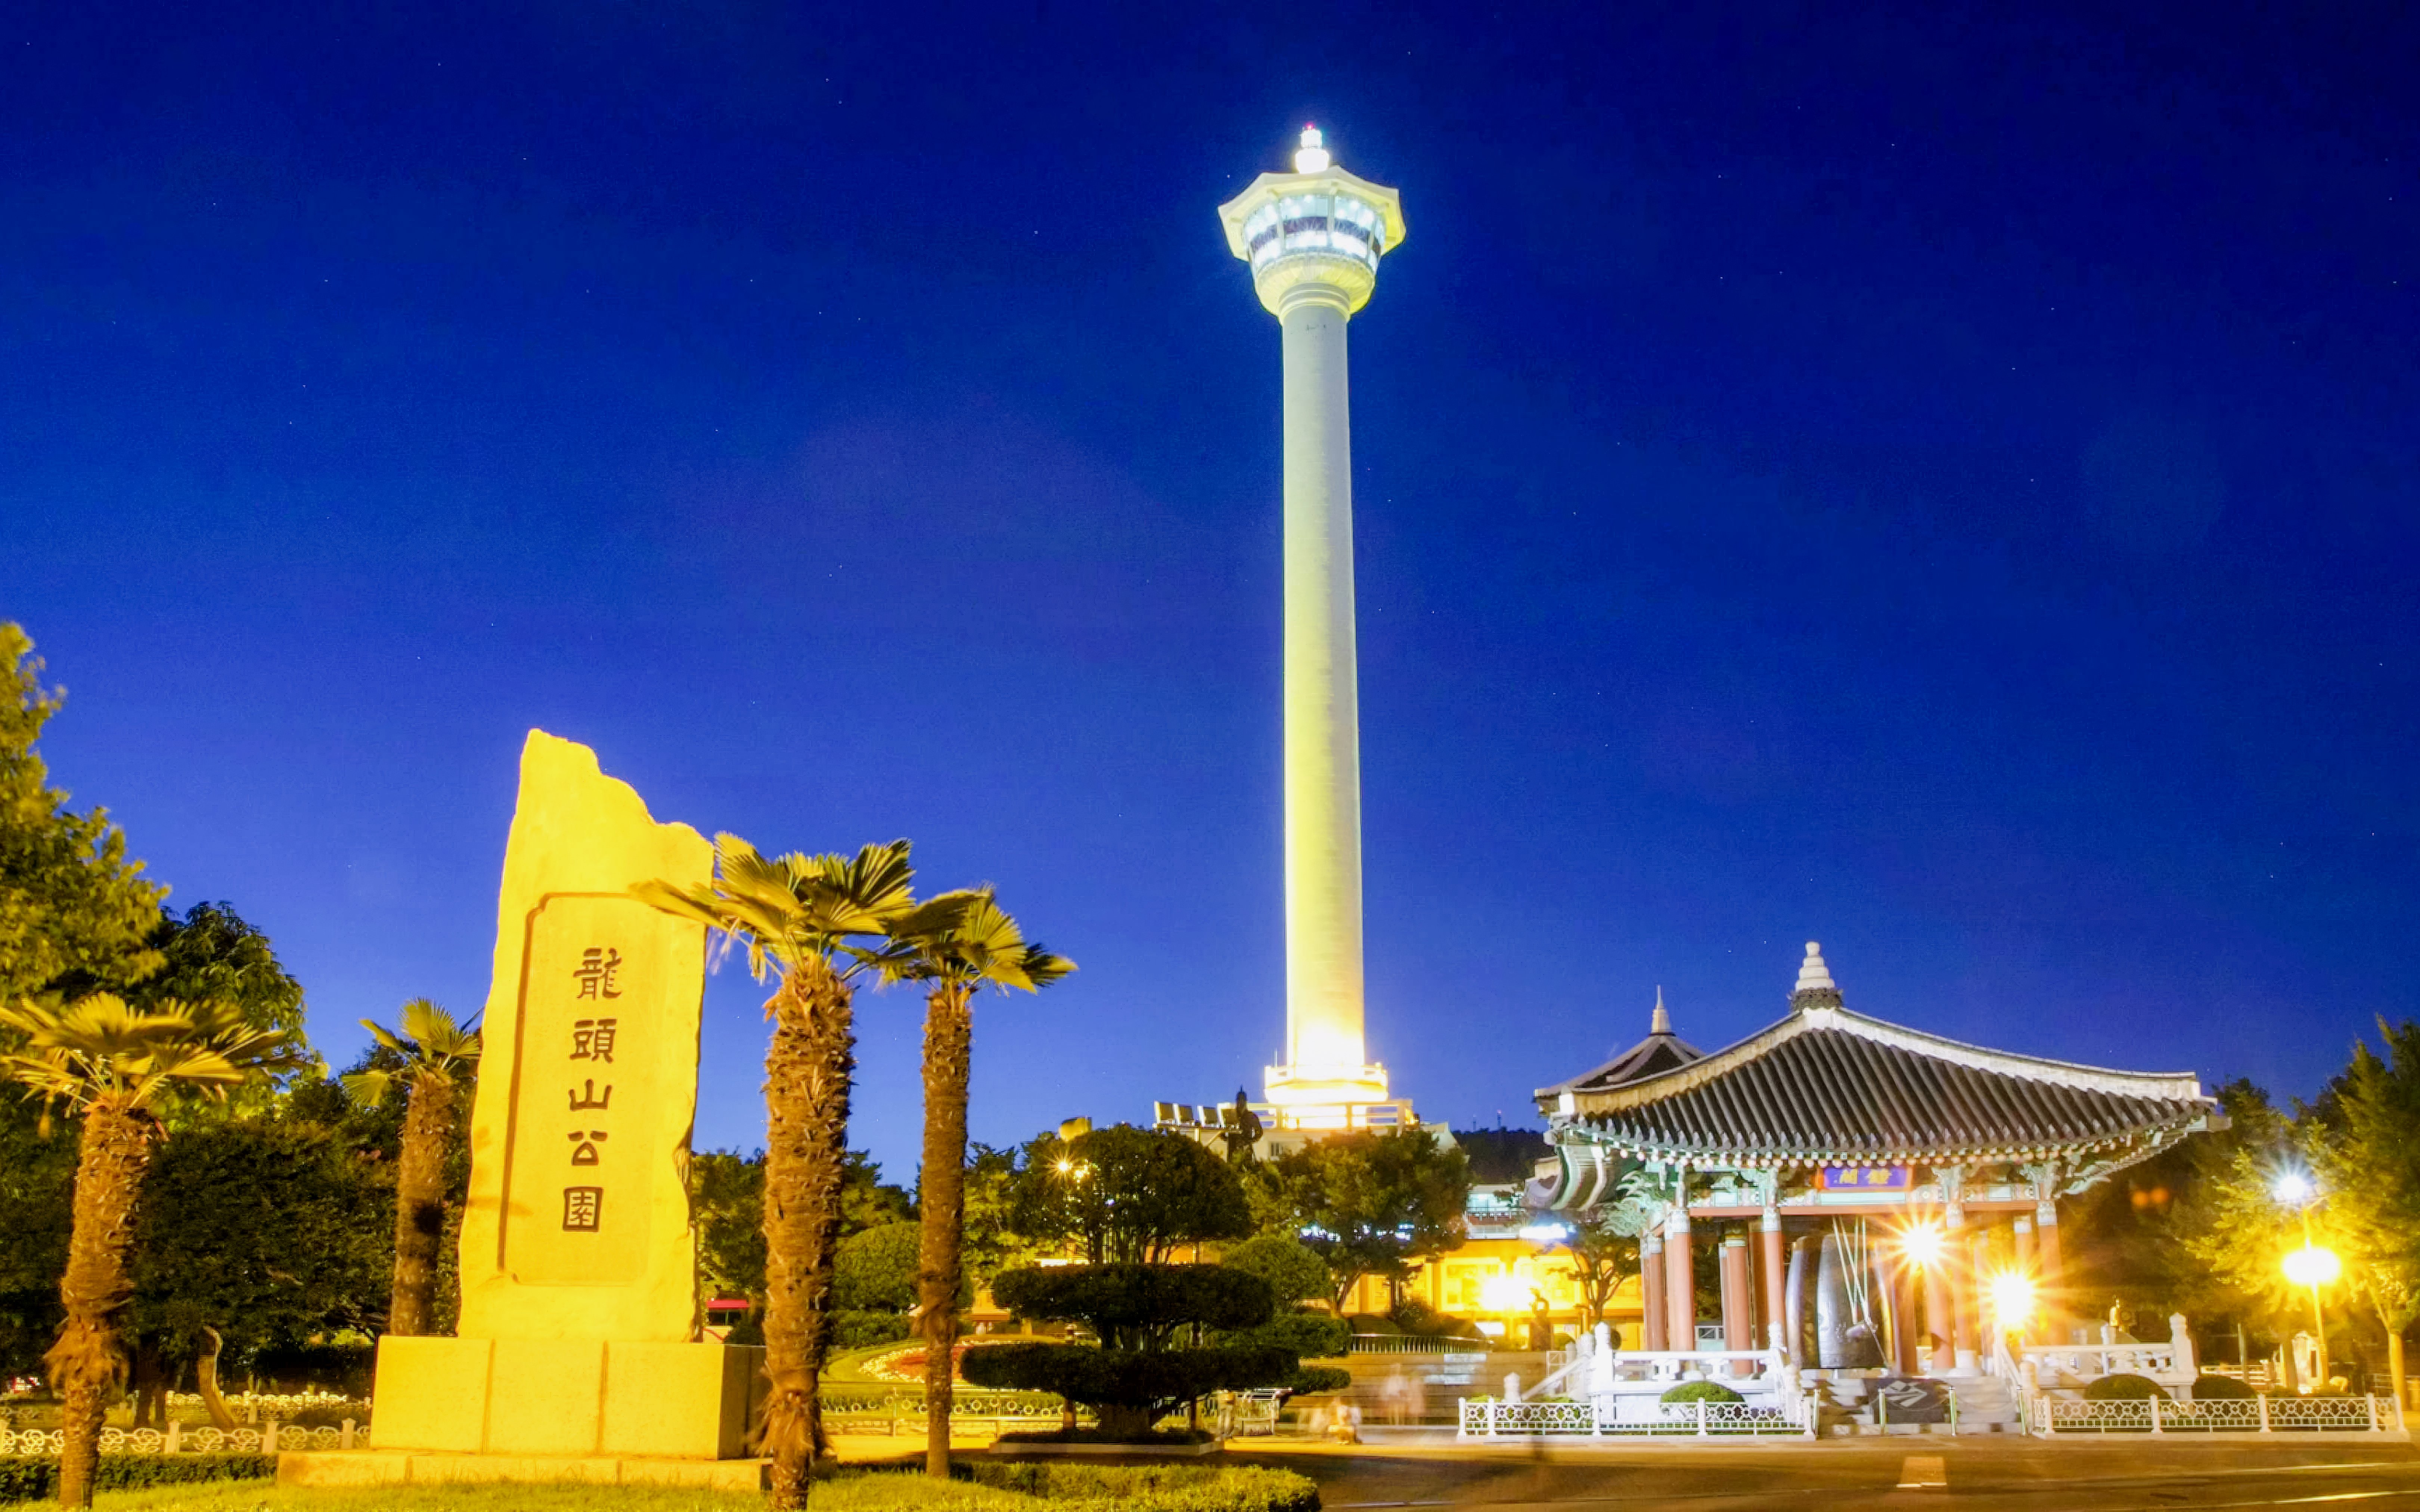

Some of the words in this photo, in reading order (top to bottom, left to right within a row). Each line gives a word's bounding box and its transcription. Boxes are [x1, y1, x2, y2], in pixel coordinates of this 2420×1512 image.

[562, 948, 621, 1231] 龍頭山公園
